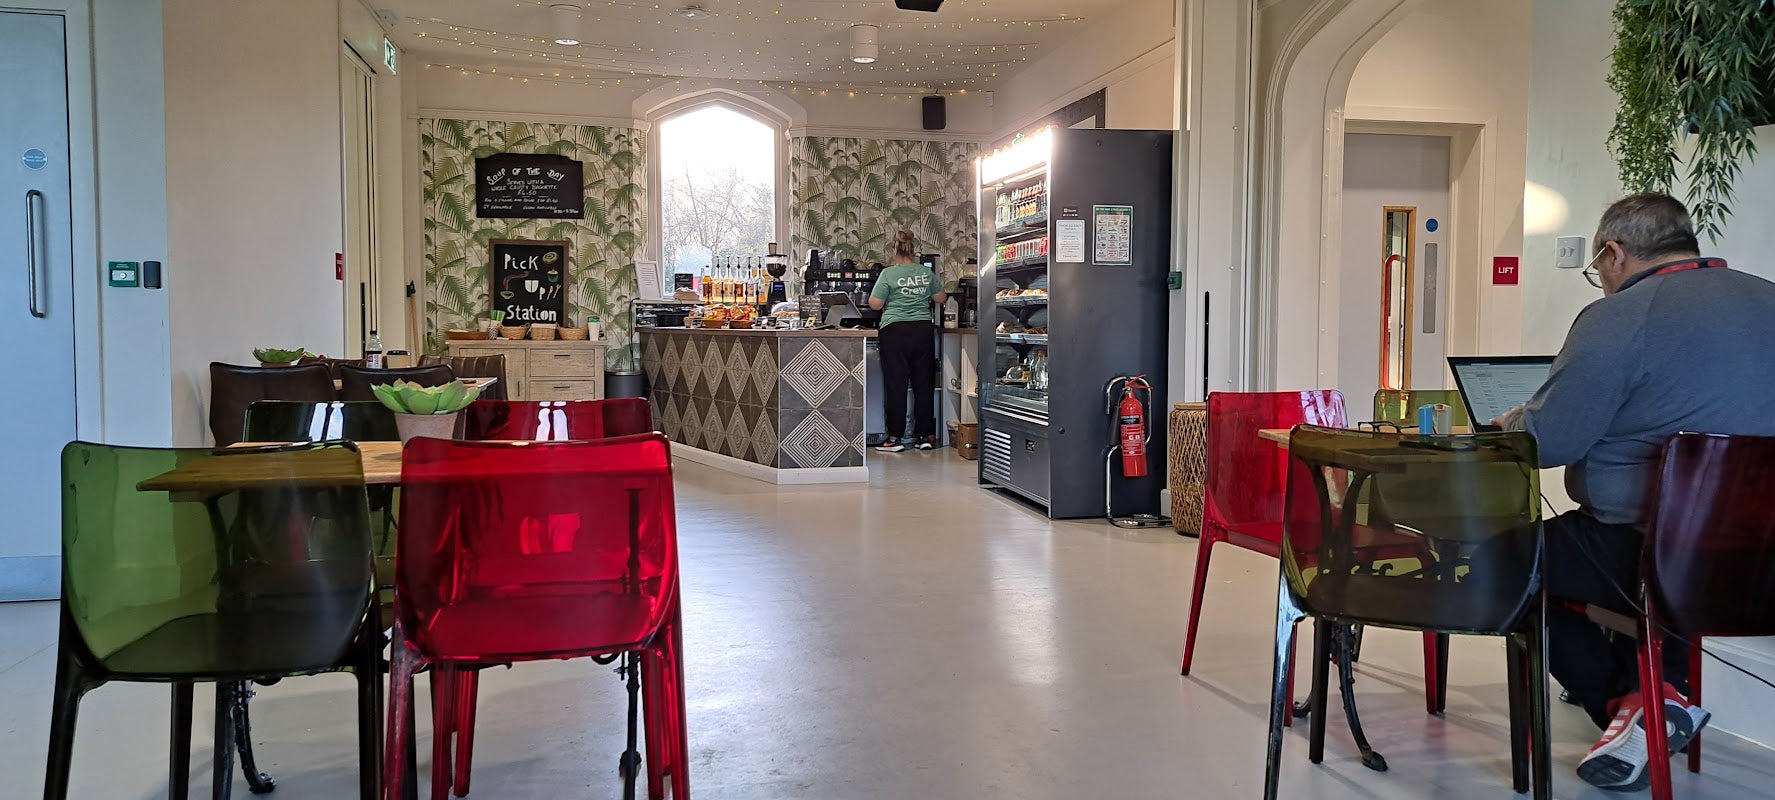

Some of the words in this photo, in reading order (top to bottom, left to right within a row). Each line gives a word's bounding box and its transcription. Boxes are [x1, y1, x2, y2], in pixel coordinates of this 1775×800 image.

[526, 167, 540, 175] THE
[547, 169, 565, 181] DAY
[1498, 266, 1514, 274] LIFT
[897, 272, 930, 287] CAFÉ
[901, 287, 927, 295] Crew
[506, 305, 557, 322] Station
